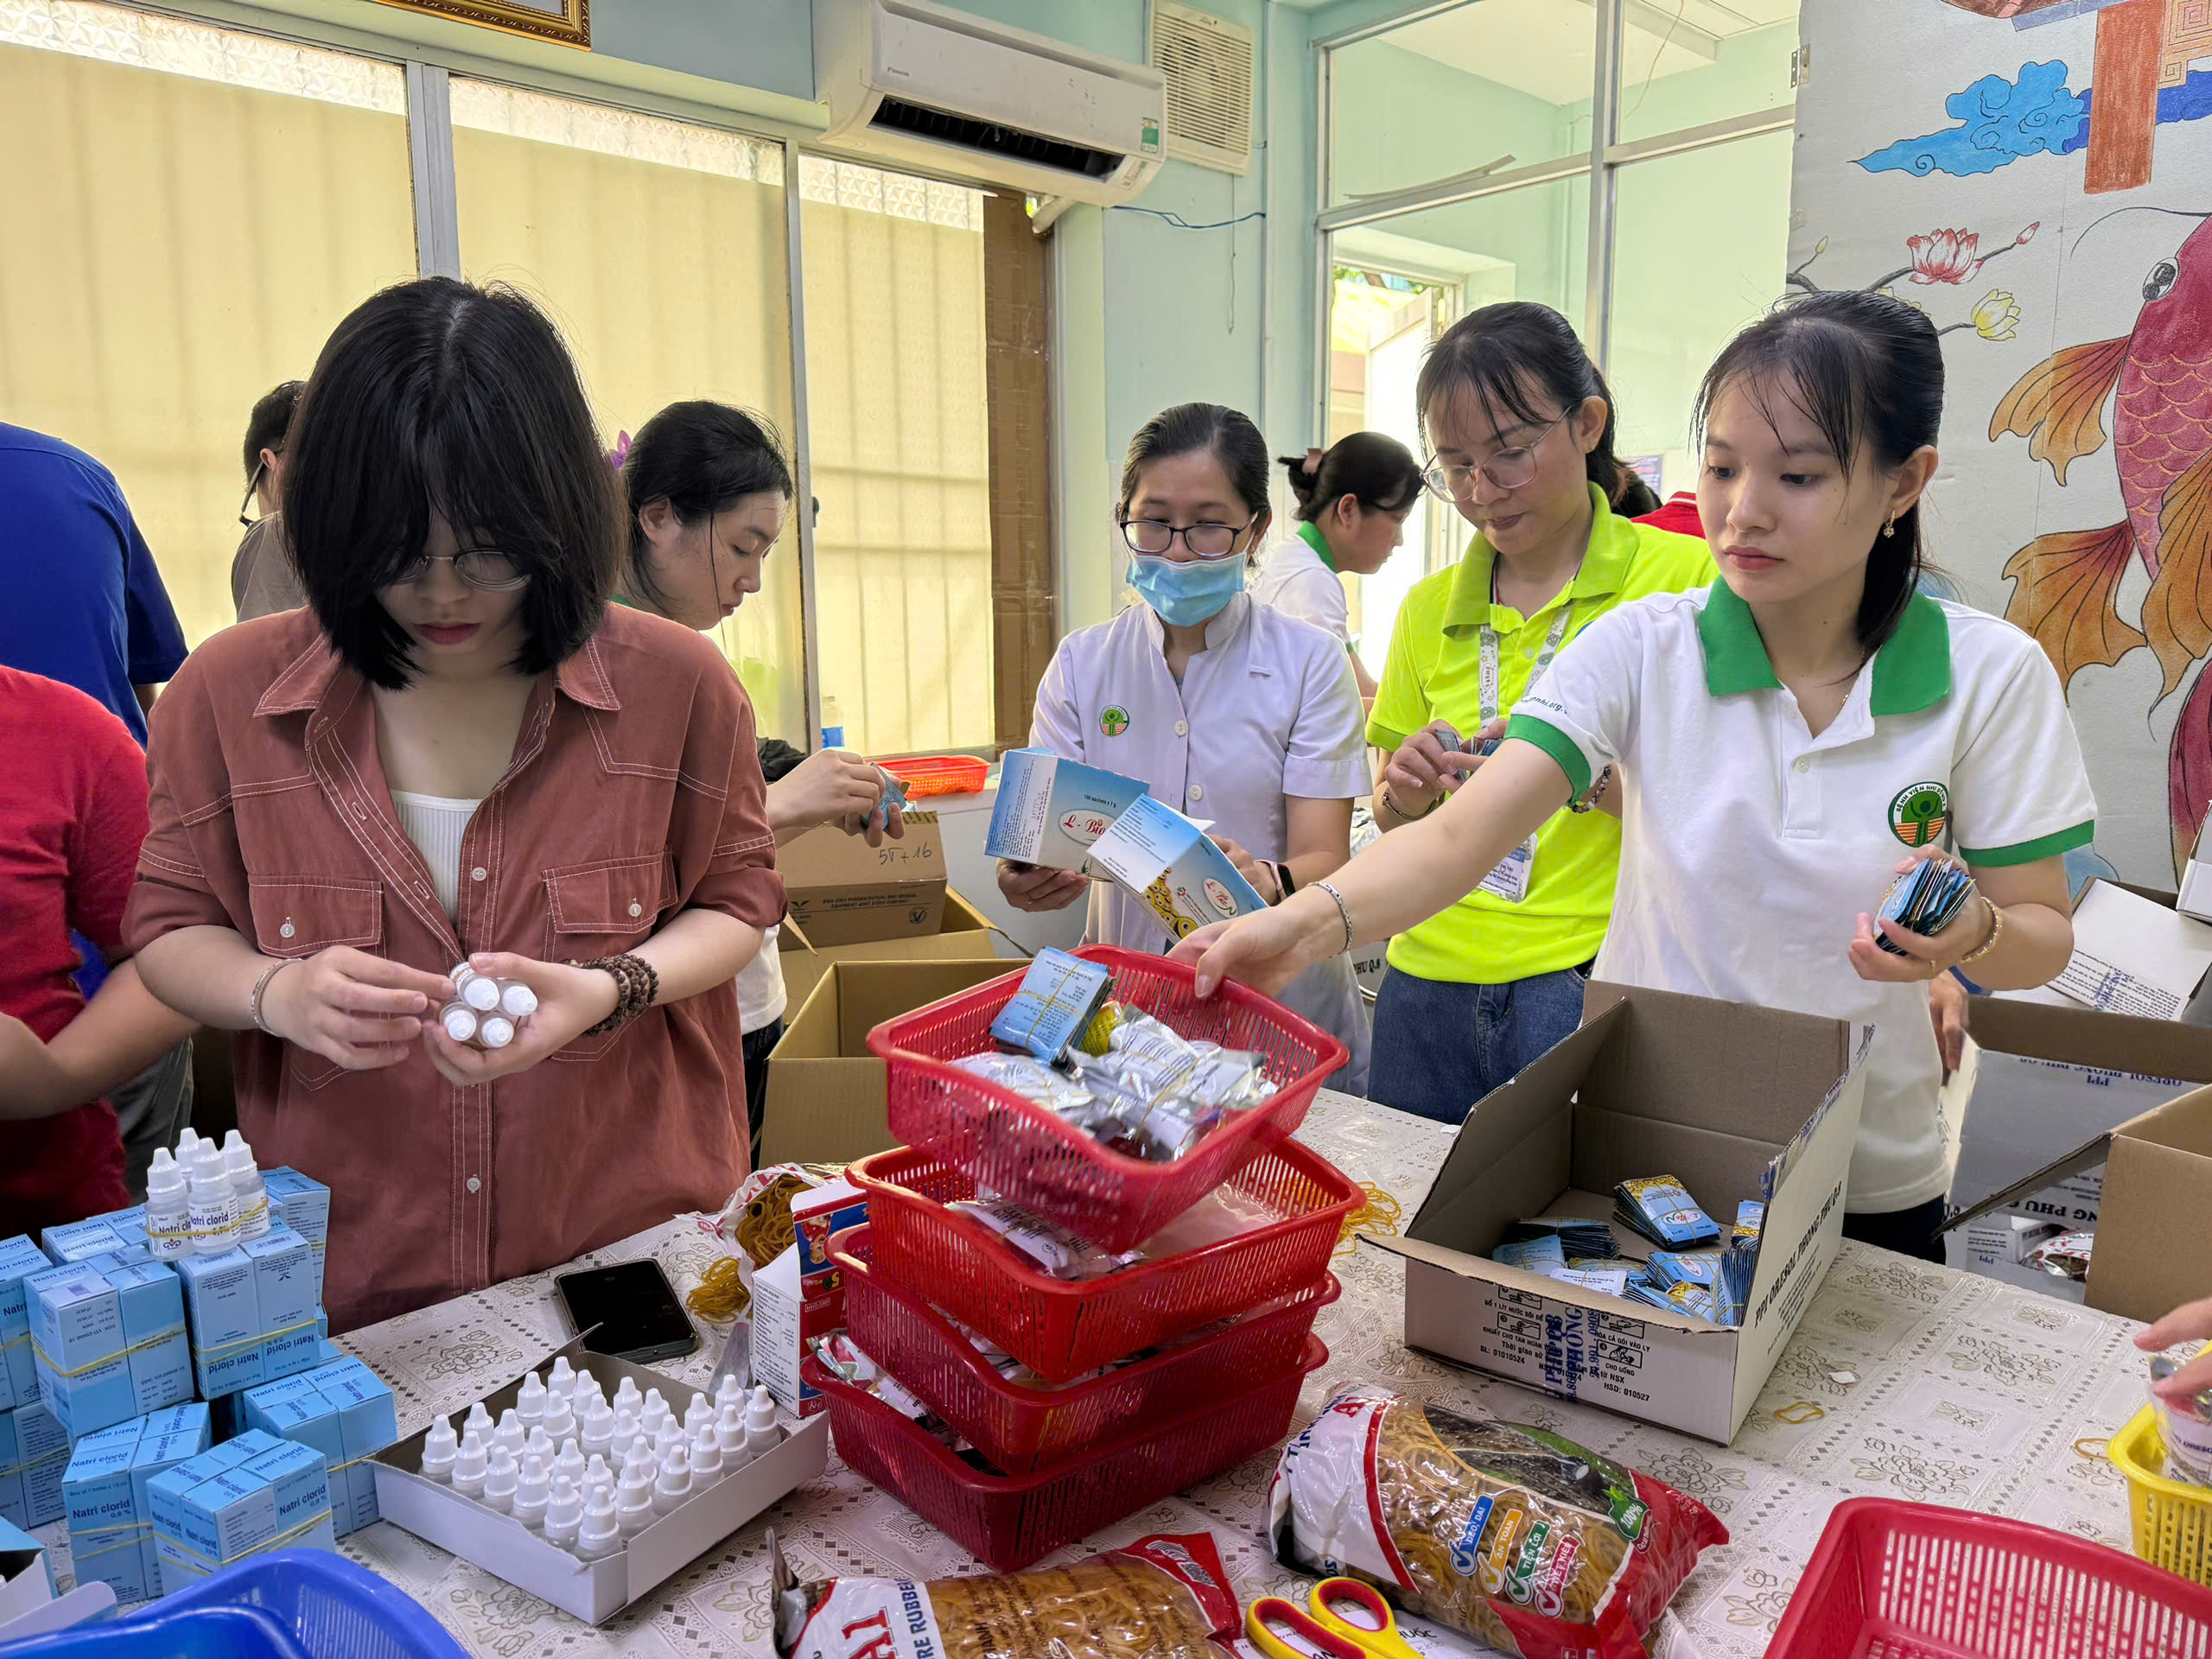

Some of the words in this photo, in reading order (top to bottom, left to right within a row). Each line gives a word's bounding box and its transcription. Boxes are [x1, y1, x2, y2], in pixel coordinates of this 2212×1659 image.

[207, 1211, 229, 1226] clorid
[292, 1333, 315, 1346] Natri
[266, 1341, 291, 1357] clorid
[236, 1352, 258, 1364] Natri
[208, 1360, 234, 1375] clorid
[1609, 1372, 1625, 1384] NSX
[1604, 1382, 1622, 1395] HSD:
[1624, 1389, 1650, 1402] 010527
[72, 1457, 97, 1468] Natri
[99, 1452, 129, 1463] clorid
[278, 1497, 301, 1516] Natri
[301, 1484, 327, 1503] clorid
[73, 1506, 99, 1519] Natri
[99, 1499, 130, 1513] clorid
[1620, 1503, 1643, 1529] 100%
[915, 1637, 934, 1659] RE
